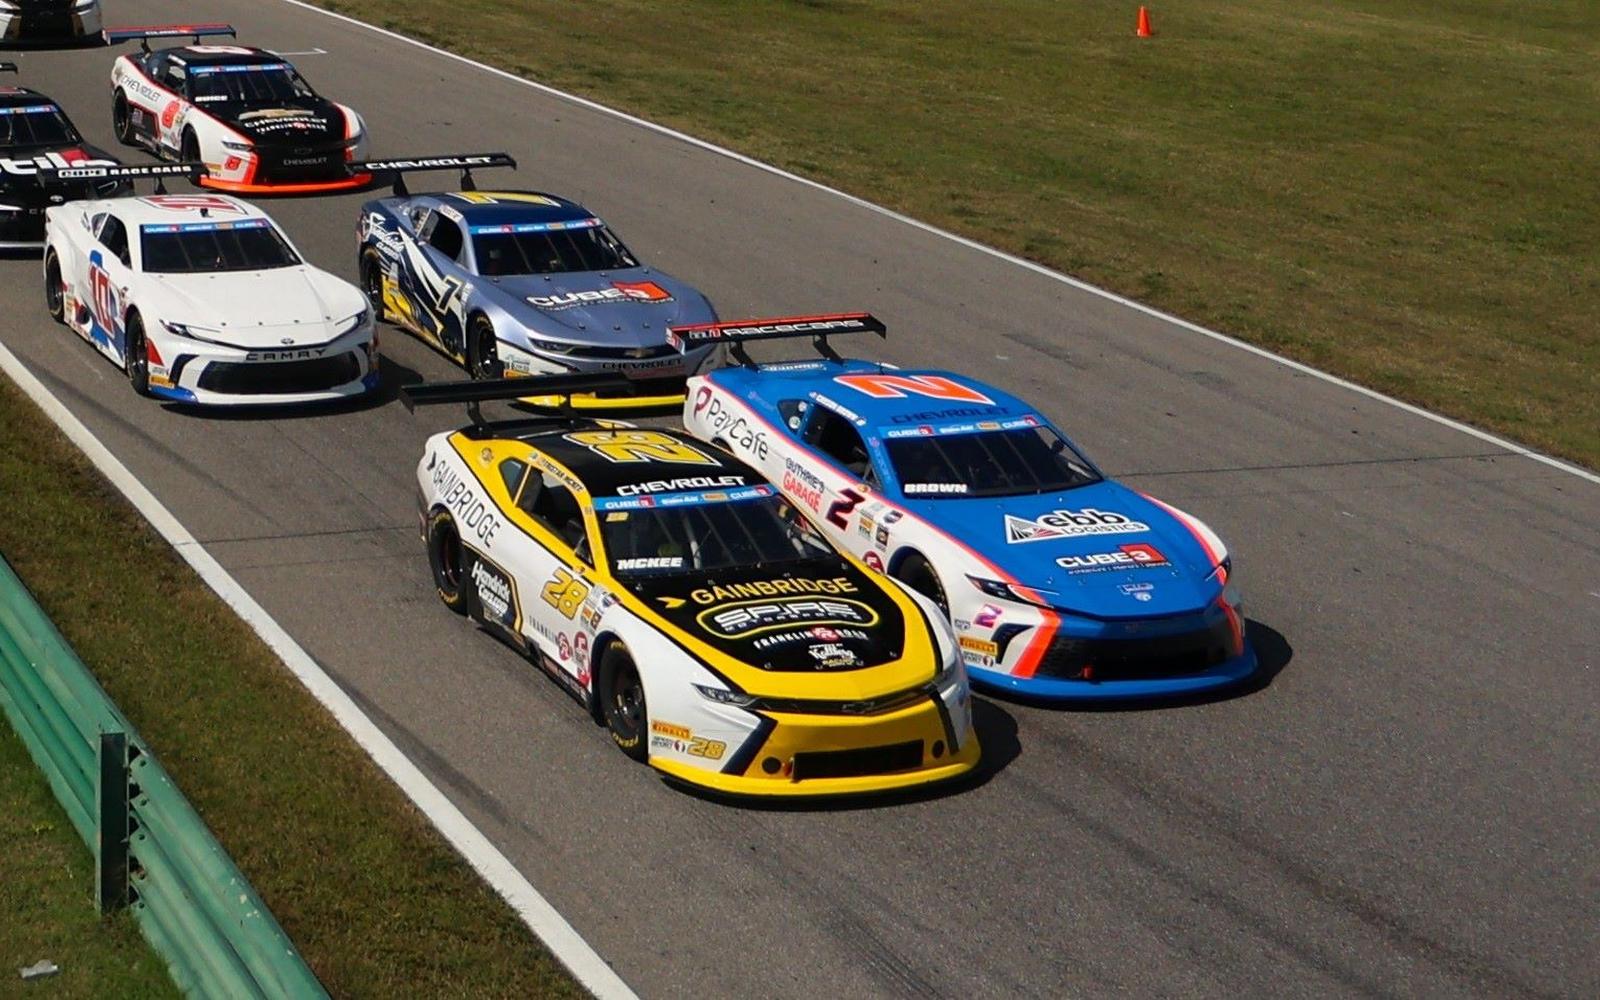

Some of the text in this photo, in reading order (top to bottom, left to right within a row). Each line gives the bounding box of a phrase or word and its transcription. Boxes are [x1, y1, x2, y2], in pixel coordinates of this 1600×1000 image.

[121, 75, 161, 102] CHEVROLET
[284, 157, 327, 166] CHEVROLET
[366, 157, 491, 169] CHEVROLET
[436, 275, 463, 315] 7
[526, 286, 653, 307] CUBE3
[602, 359, 682, 370] CHEVROLET
[833, 374, 998, 406] 2
[892, 405, 1010, 424] CHEVROLET
[707, 397, 769, 462] PayCafe
[616, 476, 745, 496] CHEVROLET
[783, 470, 823, 513] GARAGE
[904, 483, 967, 493] BROWN
[432, 460, 501, 548] GAINBRIDGE
[826, 488, 866, 532] 2
[1044, 512, 1125, 527] ebb
[1062, 522, 1144, 534] LOGISTICS
[617, 557, 683, 570] MCKEE
[1056, 550, 1152, 568] CUBE3
[471, 560, 510, 603] Hendrick
[691, 577, 858, 604] GAINBRIDGE
[540, 566, 589, 620] 28
[753, 630, 813, 649] FRANKLIN
[835, 629, 869, 640] ROAD
[688, 736, 727, 760] 28
